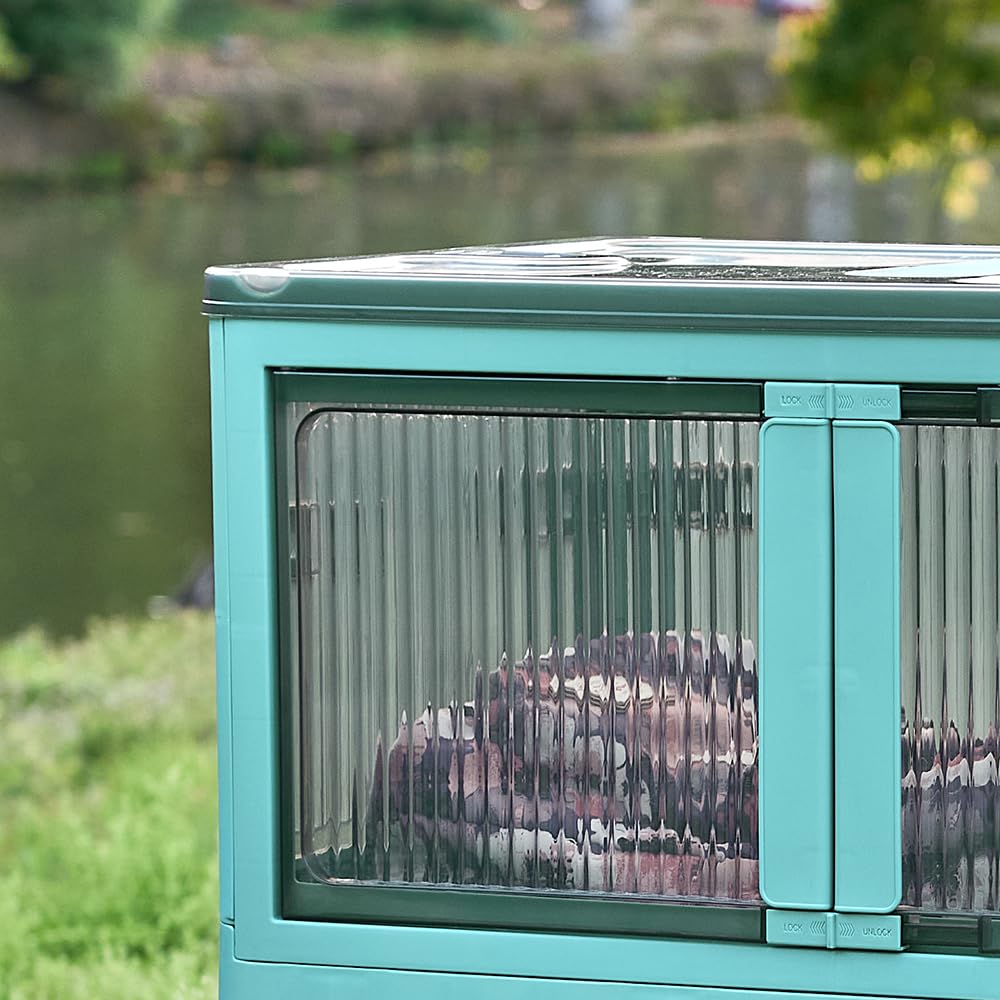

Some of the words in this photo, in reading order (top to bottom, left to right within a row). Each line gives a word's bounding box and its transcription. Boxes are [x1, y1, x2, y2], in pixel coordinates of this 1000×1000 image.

[781, 395, 801, 405] LOCK
[863, 399, 891, 407] UNLOCK
[783, 923, 803, 932] LOCK
[862, 928, 892, 936] UNLOCK
